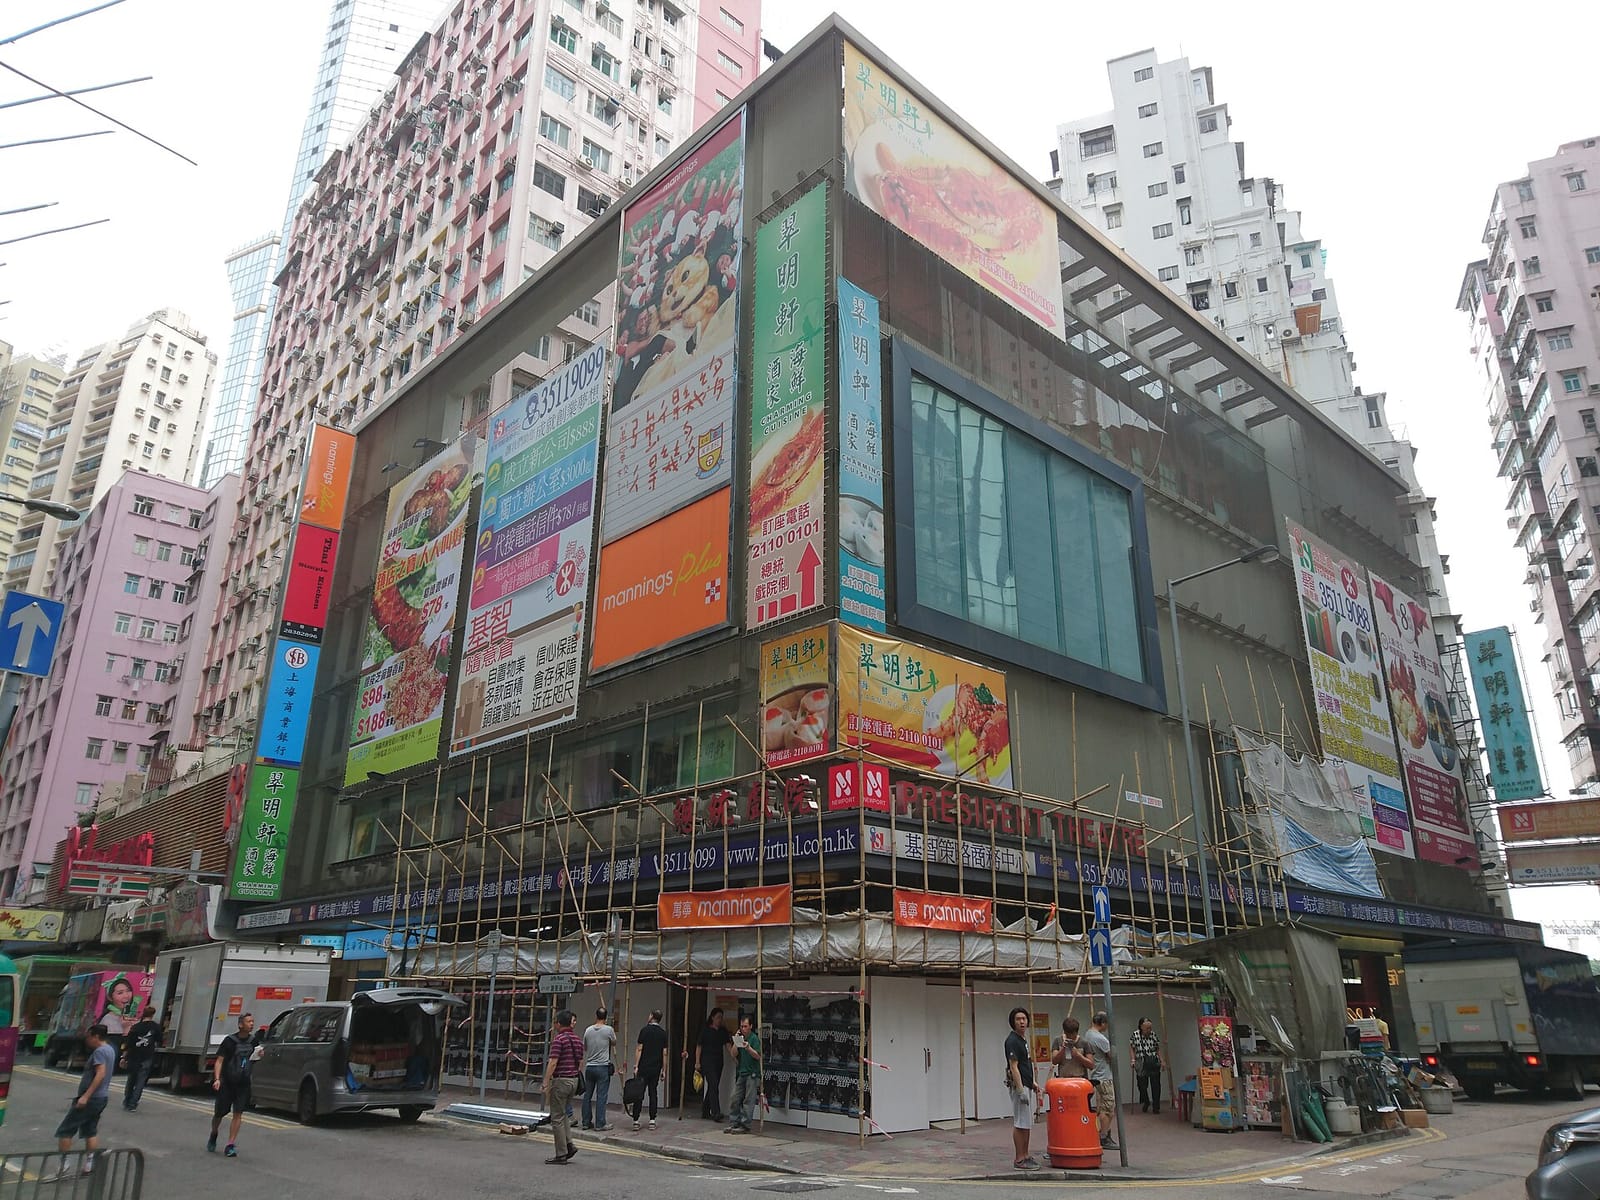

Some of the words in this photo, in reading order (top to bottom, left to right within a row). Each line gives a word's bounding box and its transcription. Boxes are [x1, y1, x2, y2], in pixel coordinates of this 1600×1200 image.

[856, 62, 920, 130] 翠明軒
[661, 158, 699, 193] mannings
[774, 210, 800, 336] 翠明軒
[852, 297, 871, 401] 翠明軒
[540, 346, 604, 418] 35119099
[760, 392, 812, 426] CHARMING
[764, 406, 808, 435] CUISINE
[324, 441, 338, 485] mannings
[841, 454, 881, 477] CHARMING
[844, 465, 879, 484] CUISINE
[762, 502, 810, 536] 訂座電話
[321, 538, 333, 565] Thai
[382, 538, 402, 561] $35
[752, 534, 784, 559] 2110
[787, 519, 819, 544] 0101
[760, 557, 784, 580] 總統
[602, 569, 673, 613] mannings
[755, 574, 790, 602] 戲院側
[421, 596, 444, 621] $78
[1319, 582, 1346, 618] 3511
[1347, 604, 1370, 633] 9088
[467, 599, 513, 653] 基智
[536, 634, 577, 667] 信心保證
[770, 637, 815, 669] 翠明軒
[860, 643, 924, 690] 翠明軒
[488, 654, 526, 687] 自置物業
[1478, 640, 1514, 727] 翠明軒
[360, 685, 383, 710] $98
[485, 676, 524, 708] 多款面積
[531, 680, 575, 713] 近在咫尺
[274, 673, 298, 756] 上海商業銀行
[356, 711, 386, 737] $188
[899, 729, 920, 744] 2110
[922, 735, 943, 751] 0101
[256, 772, 284, 844] 翠明軒
[831, 797, 855, 805] NEWPORT
[897, 780, 1046, 841] PRESIDENT
[1053, 811, 1146, 857] THEATRE
[243, 847, 258, 876] 酒家
[664, 847, 716, 873] 35119099
[905, 833, 1031, 871] 基智策略商務中心
[104, 875, 119, 893] 7
[236, 882, 278, 890] CHARMING
[1084, 863, 1129, 888] 3519099
[238, 888, 274, 897] CUISINE
[672, 901, 692, 919] 萬寧
[697, 893, 773, 920] mannings
[923, 903, 986, 929] mannings
